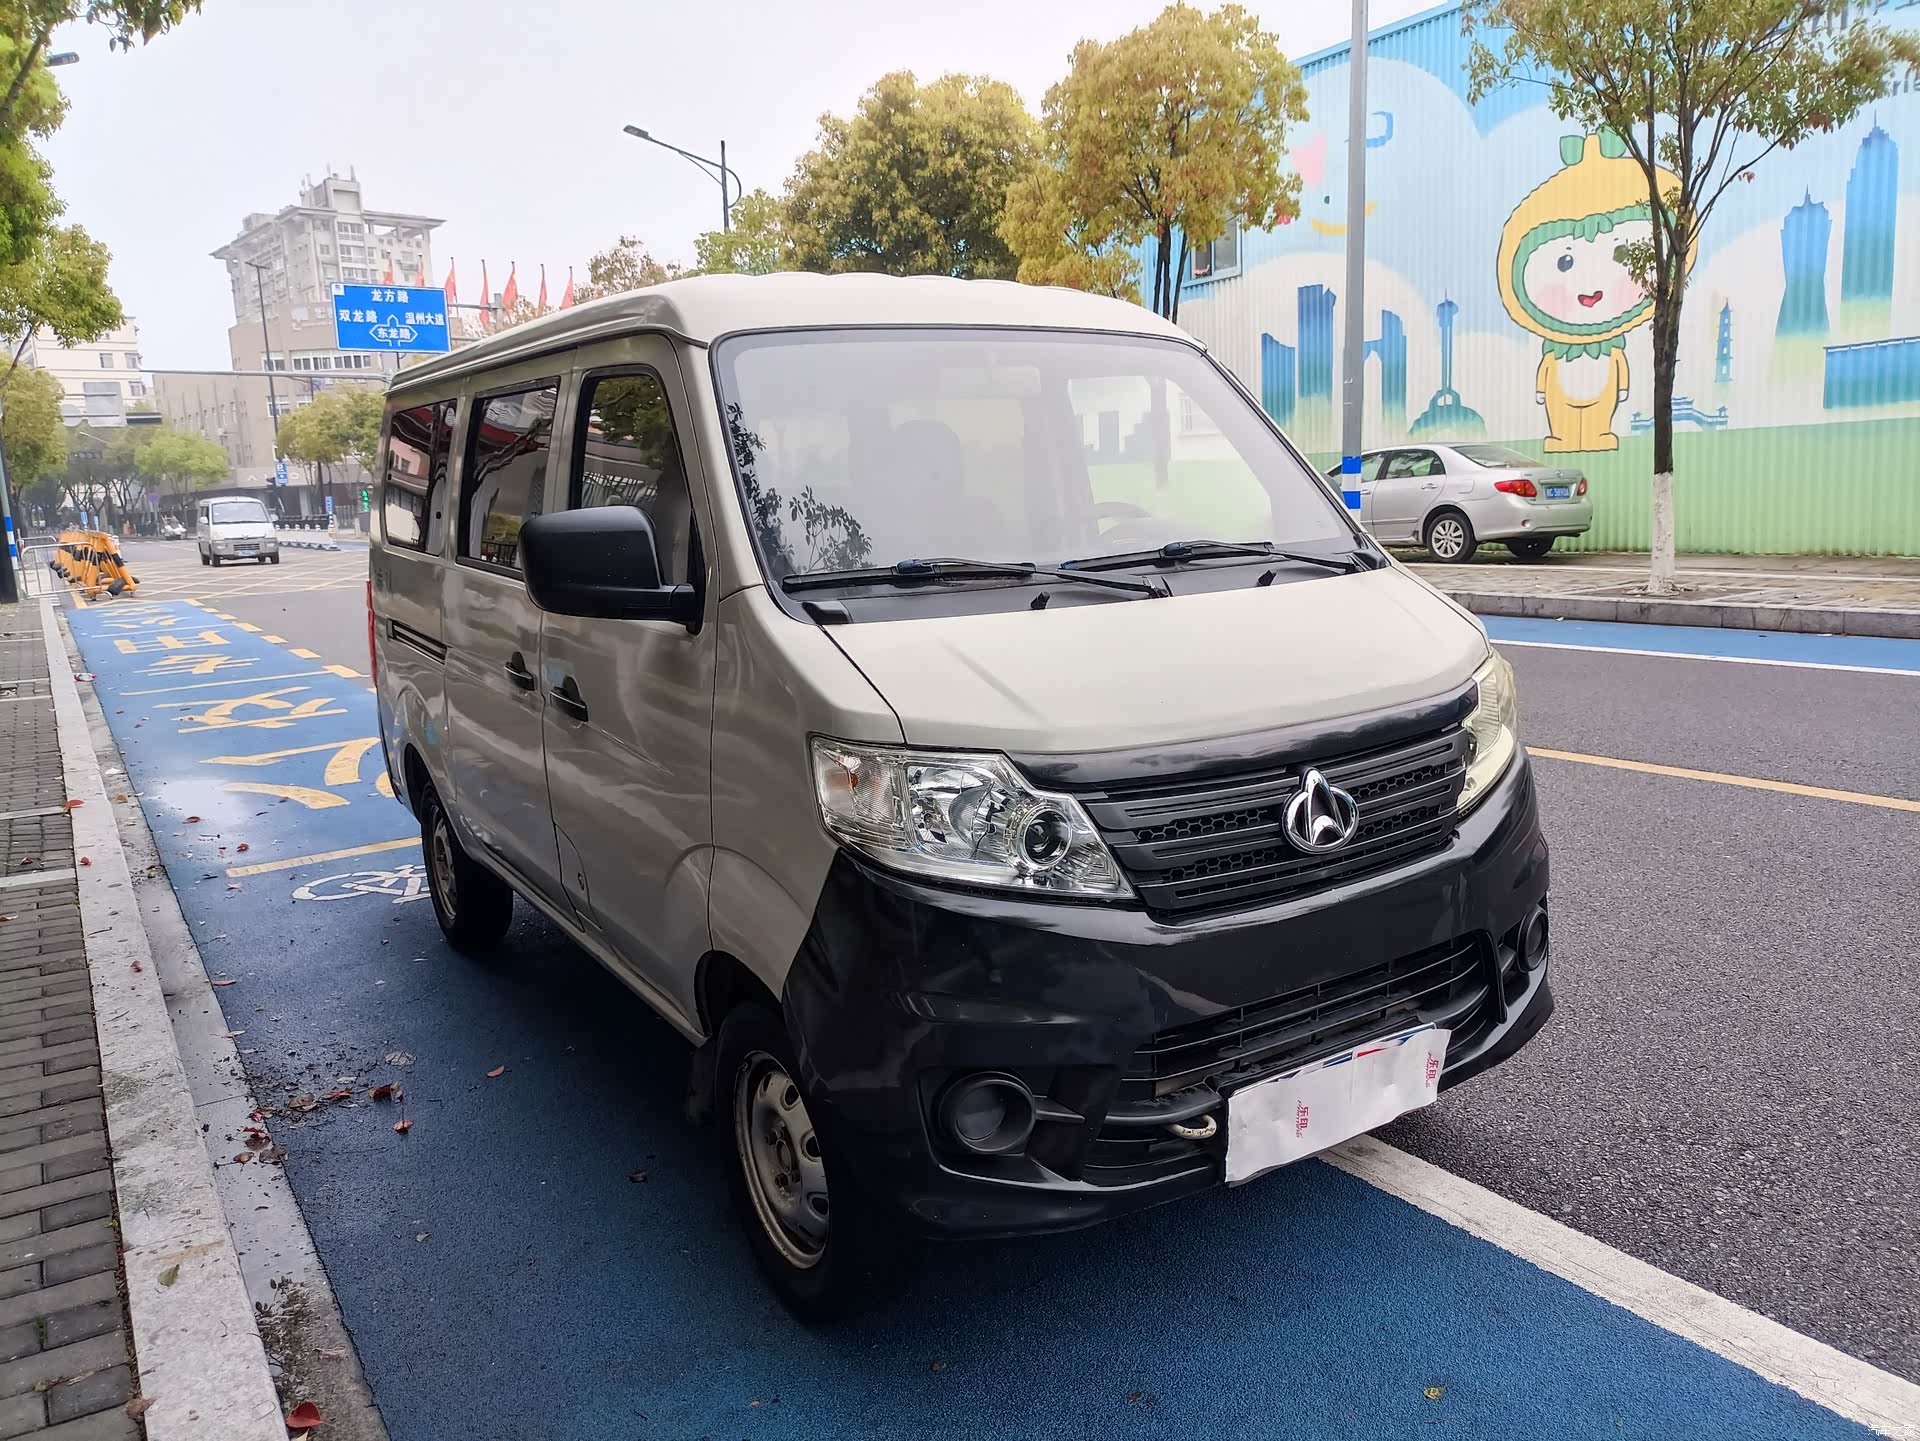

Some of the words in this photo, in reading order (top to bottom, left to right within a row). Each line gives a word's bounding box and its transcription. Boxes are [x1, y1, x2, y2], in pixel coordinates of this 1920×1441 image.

[371, 288, 409, 303] 龙方路
[338, 309, 378, 323] 双龙路
[405, 312, 445, 326] 温州大道
[377, 328, 411, 340] 东龙路
